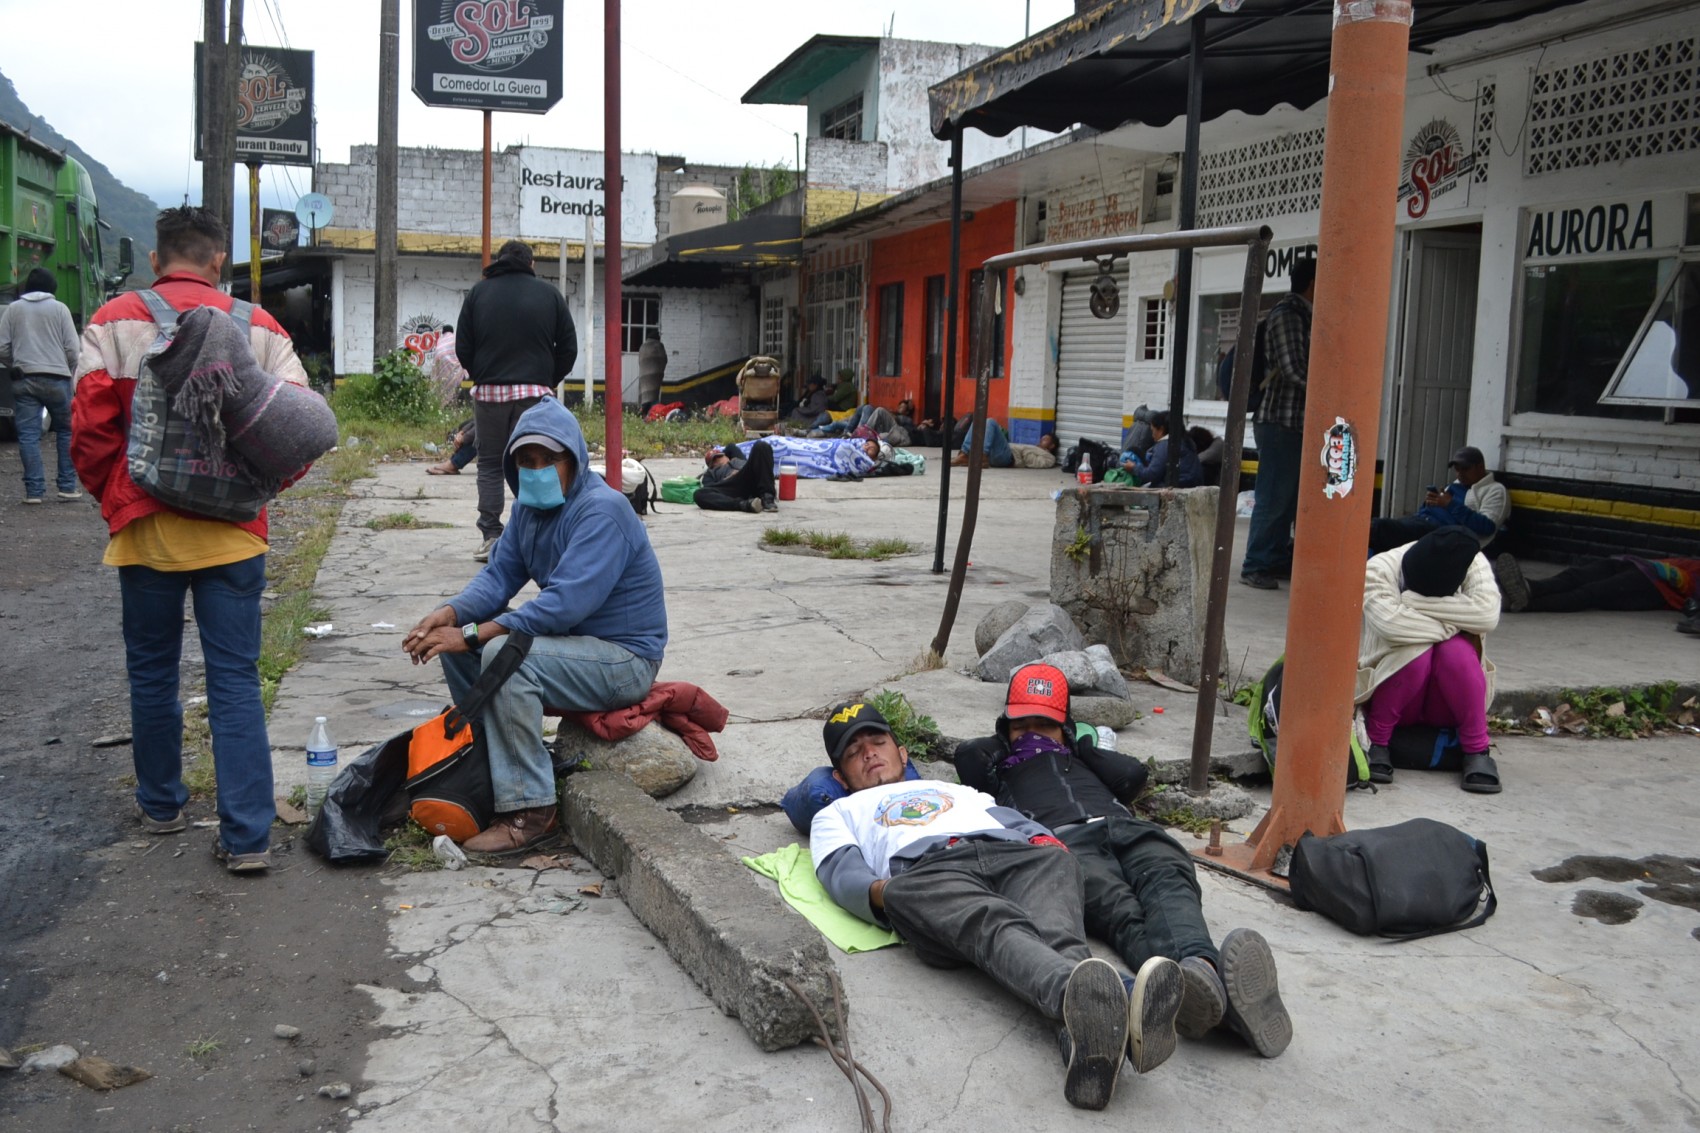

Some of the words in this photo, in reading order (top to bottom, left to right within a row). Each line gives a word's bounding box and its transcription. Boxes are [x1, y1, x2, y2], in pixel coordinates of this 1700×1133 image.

[451, 0, 531, 64] SOL
[493, 34, 529, 47] CERVEZA
[440, 76, 491, 92] Comedor
[494, 80, 505, 92] La
[508, 81, 541, 95] Guera
[256, 102, 286, 112] CERVEZA
[269, 141, 302, 153] Dandy
[522, 167, 629, 192] Restaurat
[1407, 143, 1459, 219] SOL
[1431, 180, 1457, 200] CERVEZA
[541, 195, 606, 217] Brenda
[1526, 200, 1653, 257] AURORA
